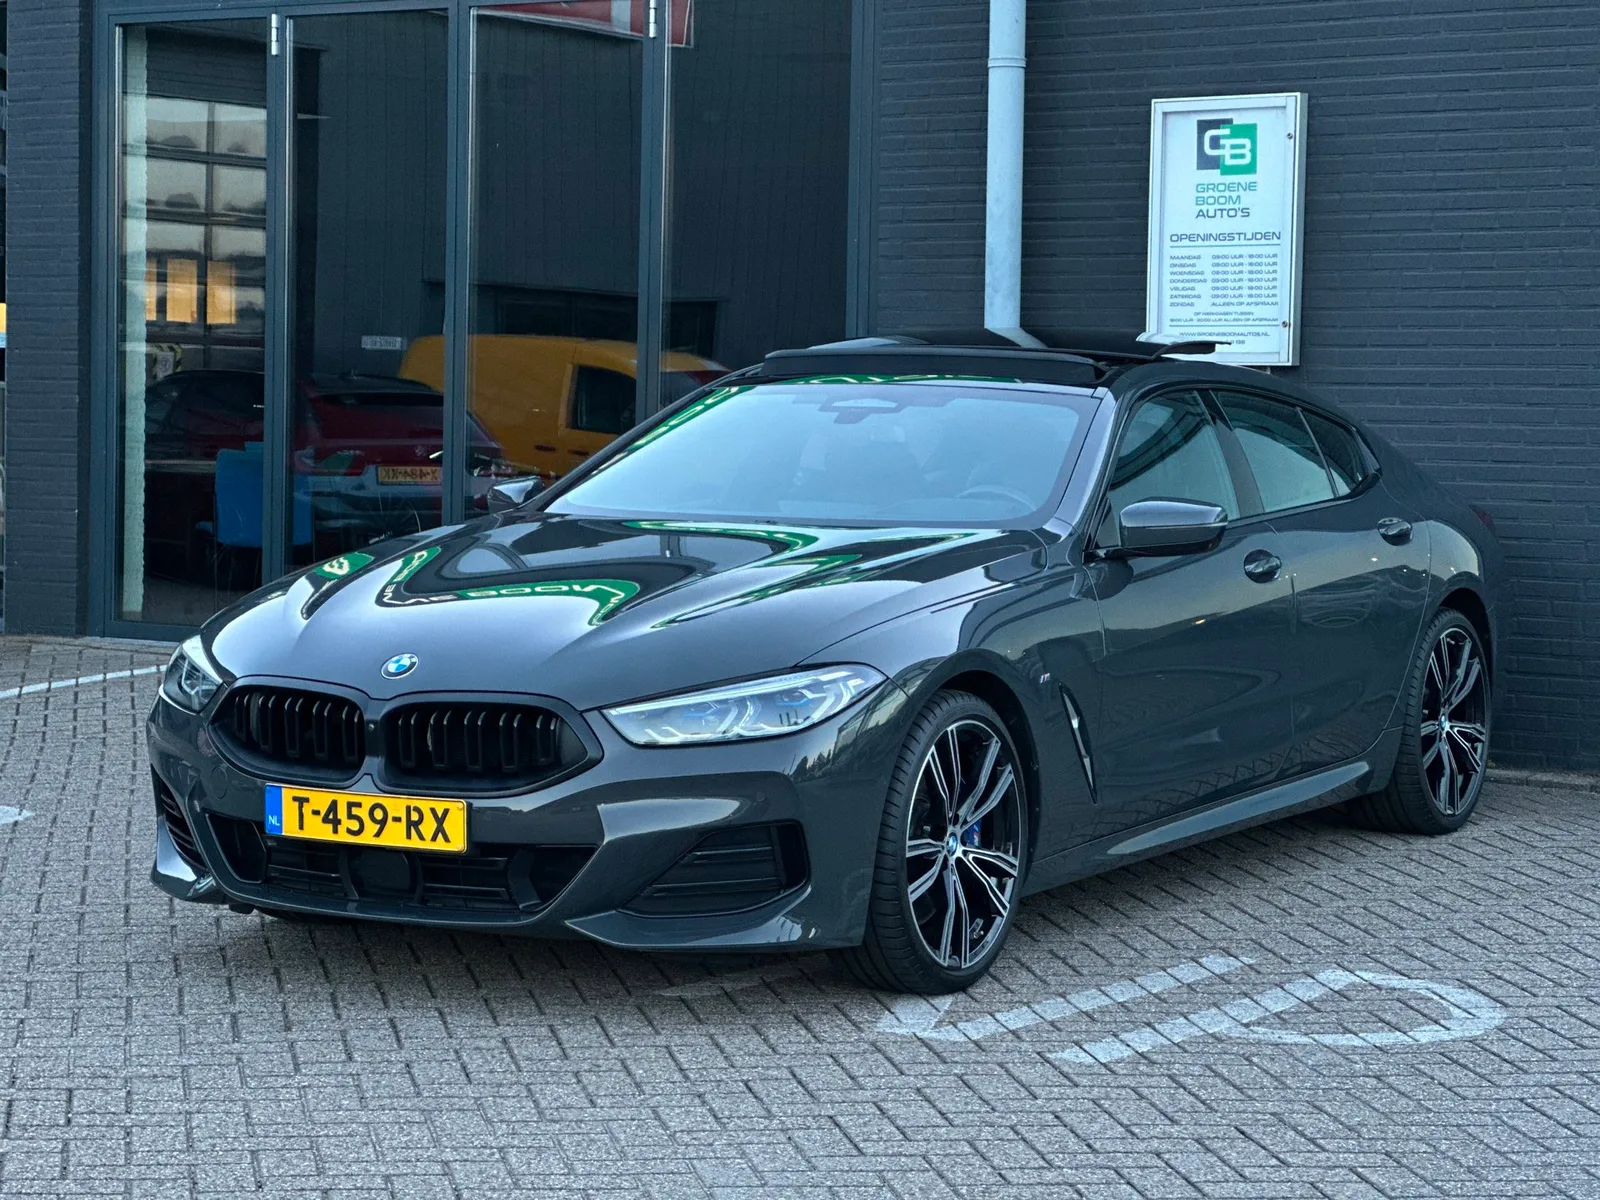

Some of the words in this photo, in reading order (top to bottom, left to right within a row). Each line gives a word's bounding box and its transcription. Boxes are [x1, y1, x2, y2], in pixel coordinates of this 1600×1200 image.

[1195, 181, 1258, 193] GROENE
[1195, 194, 1241, 206] BOOM
[1195, 207, 1251, 219] AUTO'S
[1169, 231, 1281, 243] OPENINGSTIJDEN
[268, 815, 280, 826] NL
[291, 795, 451, 843] T-459-RX
